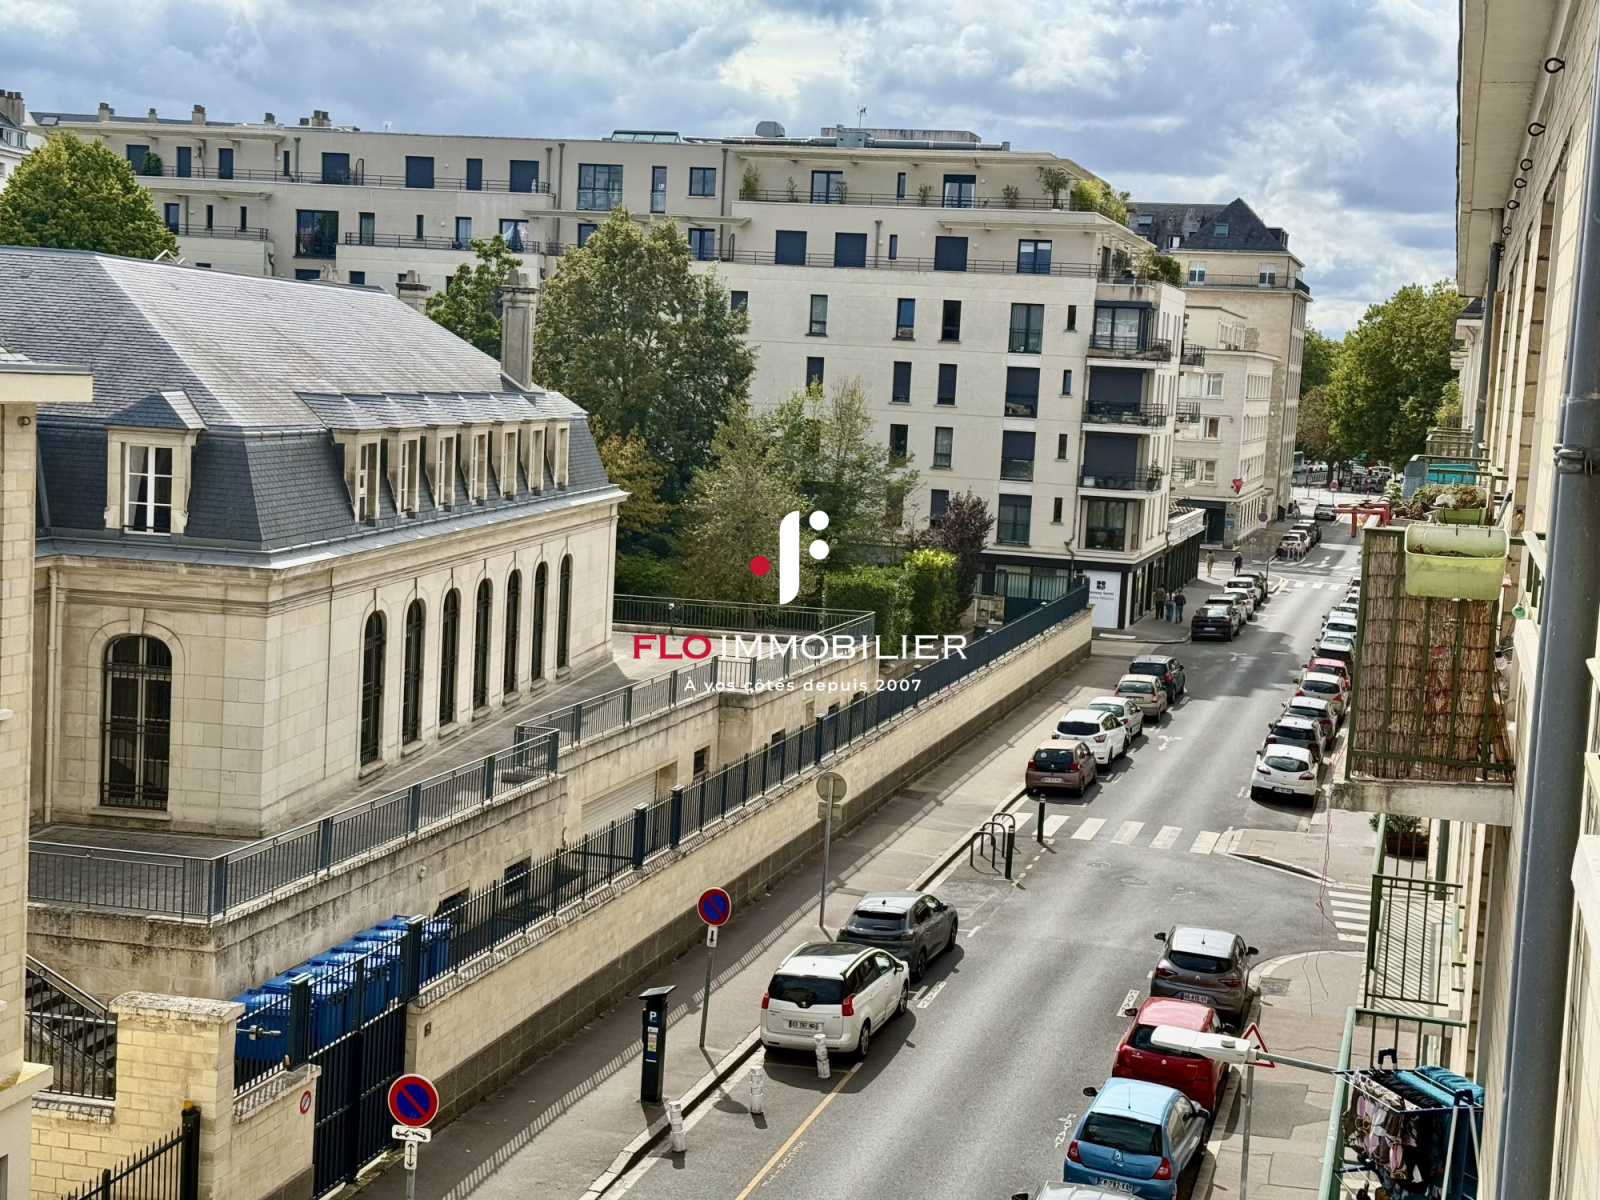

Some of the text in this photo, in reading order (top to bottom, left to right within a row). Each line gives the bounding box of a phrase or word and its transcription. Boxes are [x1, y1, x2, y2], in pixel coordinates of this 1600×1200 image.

[649, 1010, 657, 1021] P
[1054, 1113, 1077, 1148] PAYANT
[761, 1140, 806, 1188] SECURITE
